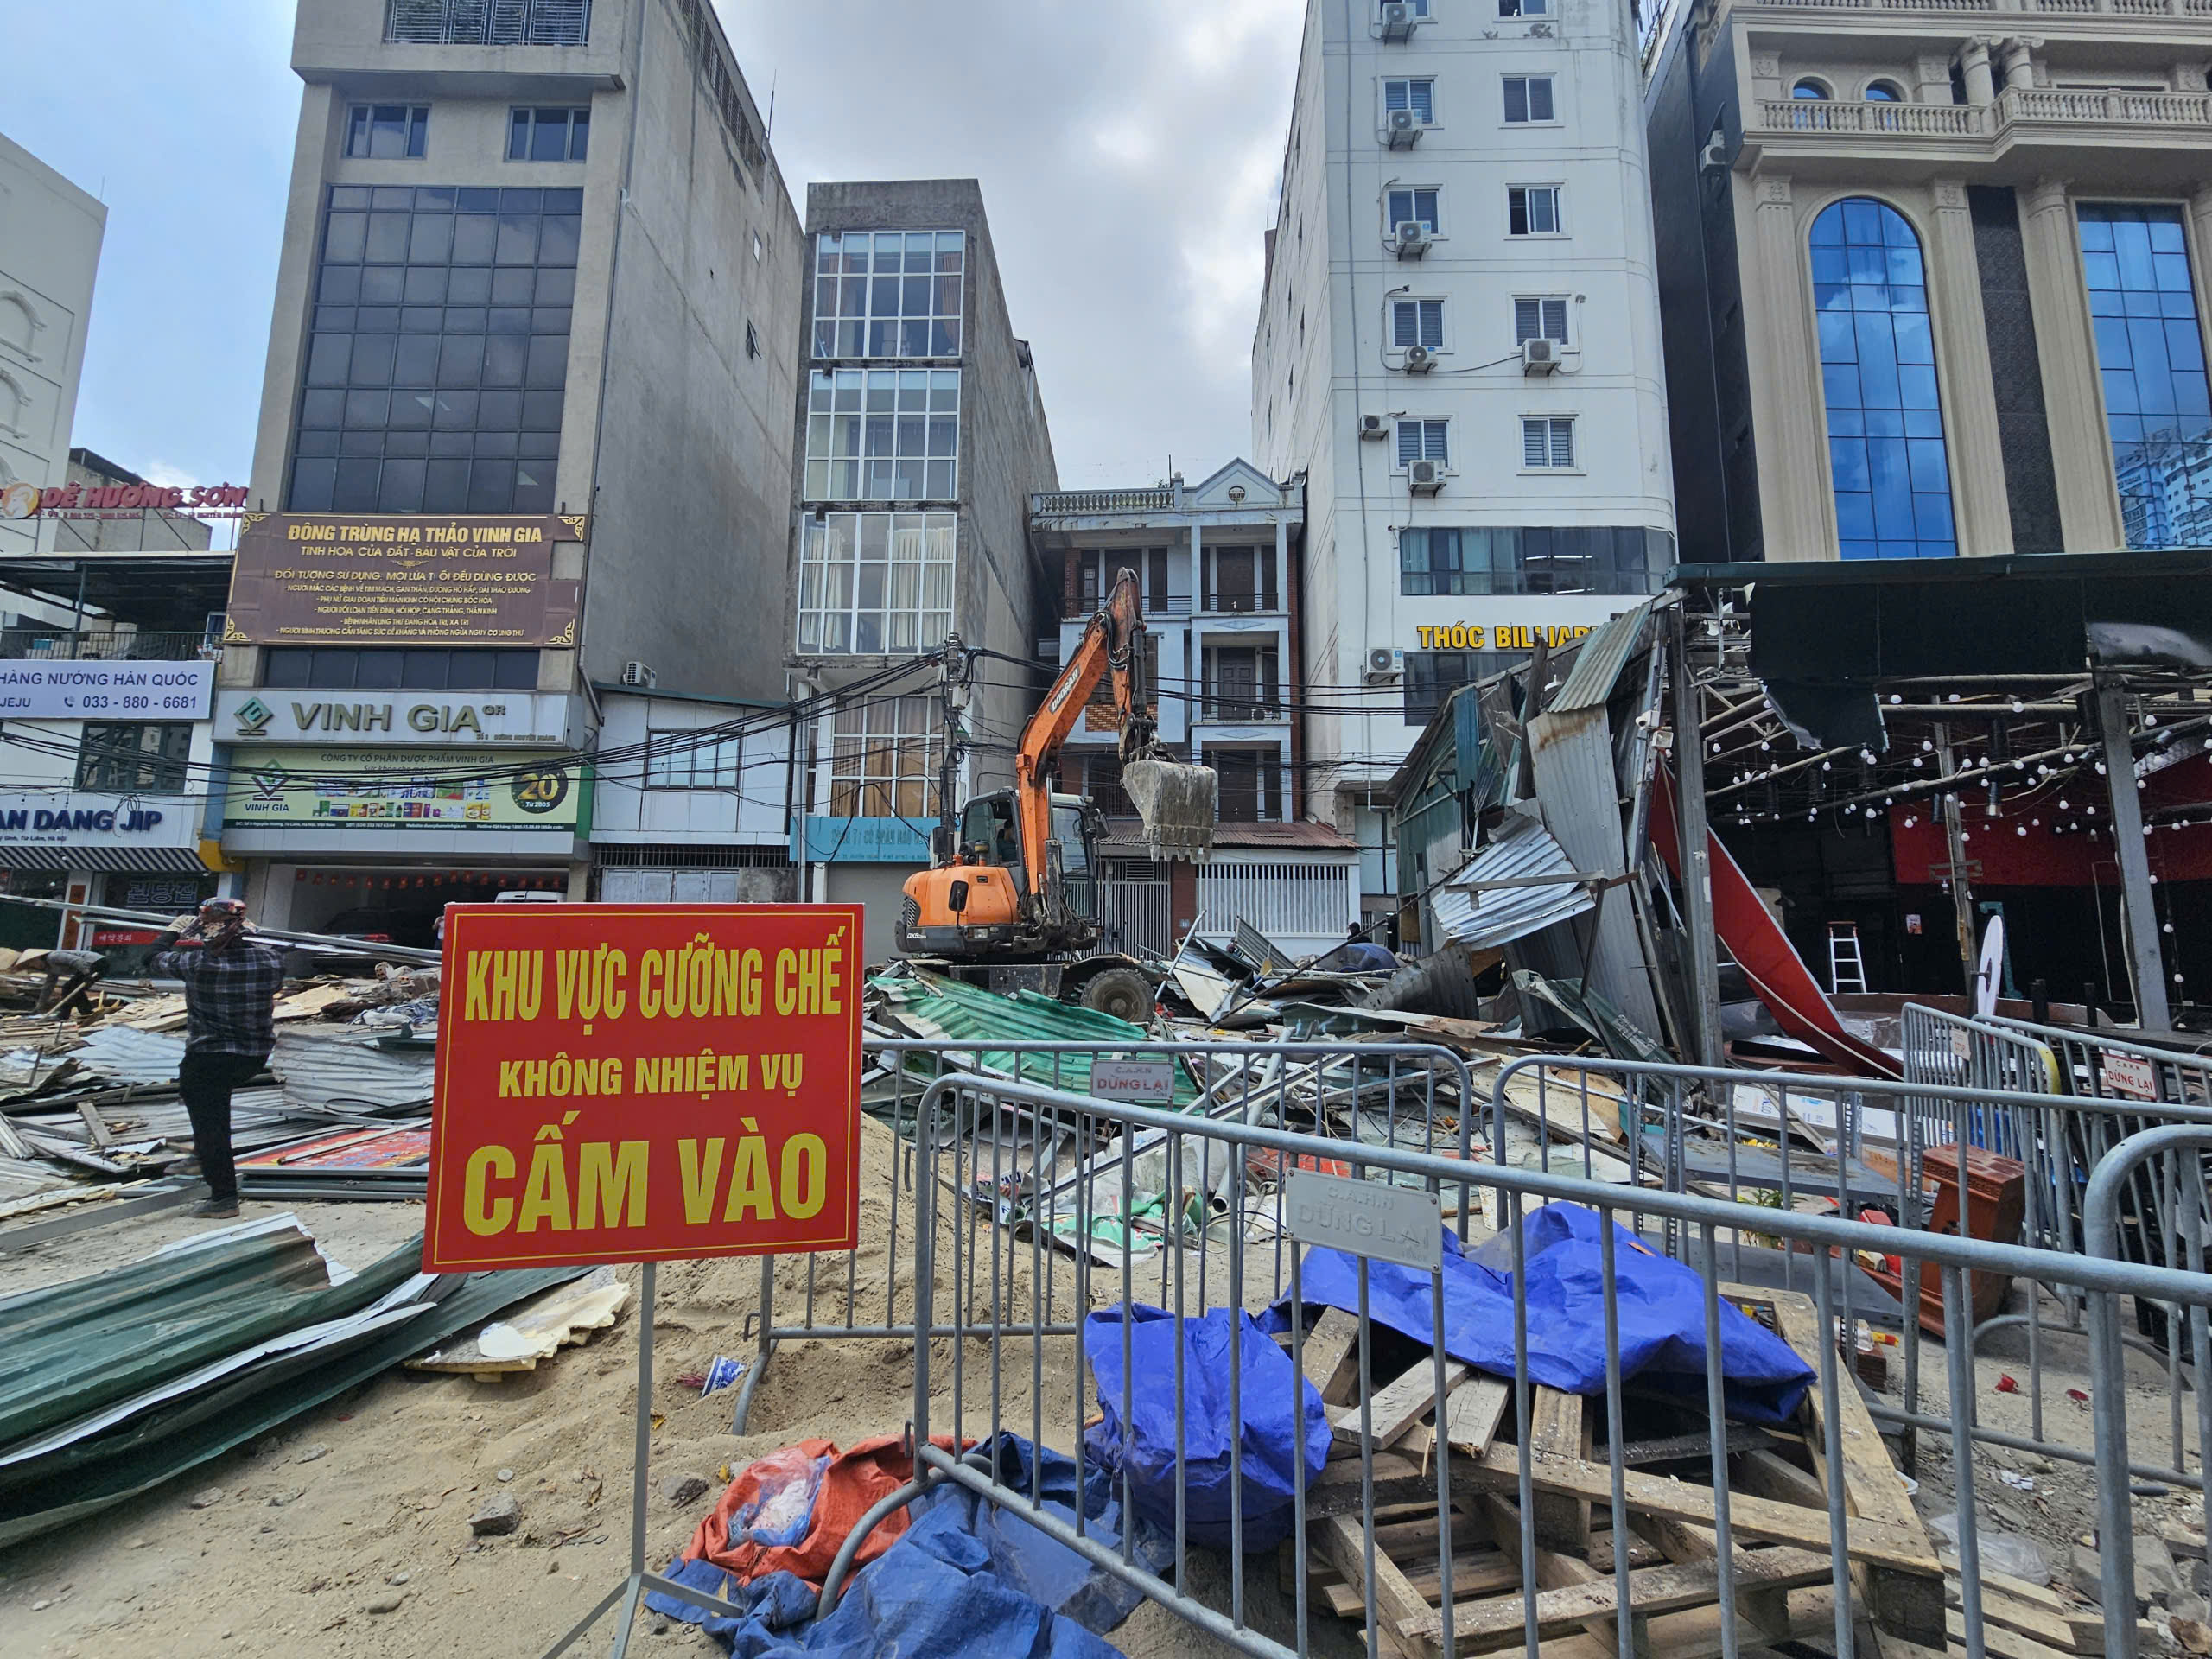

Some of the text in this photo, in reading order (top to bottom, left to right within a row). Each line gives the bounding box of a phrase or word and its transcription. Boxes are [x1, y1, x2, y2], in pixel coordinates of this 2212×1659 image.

[83, 481, 183, 508] HƯƠNG
[189, 481, 249, 508] SƠN
[288, 522, 543, 546] ĐÔNG TRÙNG HẠ THẢO VINH GIA
[301, 546, 326, 556] TINH
[328, 546, 353, 557] HOA
[358, 543, 382, 557] CỦA
[386, 544, 409, 558] ĐẤT
[462, 544, 487, 558] CỦA
[297, 570, 334, 582] TƯỢNG
[386, 571, 406, 582] MỌI
[505, 571, 537, 583] ĐƯỢC
[1417, 620, 1485, 649] THÓC
[48, 669, 108, 686] NƯỚNG
[113, 671, 147, 686] HÀN
[1051, 667, 1079, 712] DOOSAN
[0, 697, 31, 708] JEJU
[82, 696, 108, 709] 033
[123, 696, 149, 709] 880
[162, 696, 197, 709] 6681
[291, 702, 506, 734] VINH GIA GR
[321, 753, 346, 762] CÔNG
[347, 753, 359, 763] TY
[455, 754, 477, 764] VINH
[479, 755, 494, 764] GIA
[518, 772, 559, 801] 20
[245, 803, 289, 812] VINH GIA
[33, 810, 113, 830] DANG
[120, 810, 162, 831] JIP
[464, 925, 846, 1036] KHU VỰC CƯỠNG CHẾ
[499, 1048, 804, 1100] KHÔNG NHIỆM VỤ
[463, 1110, 827, 1236] CẤM VÀO
